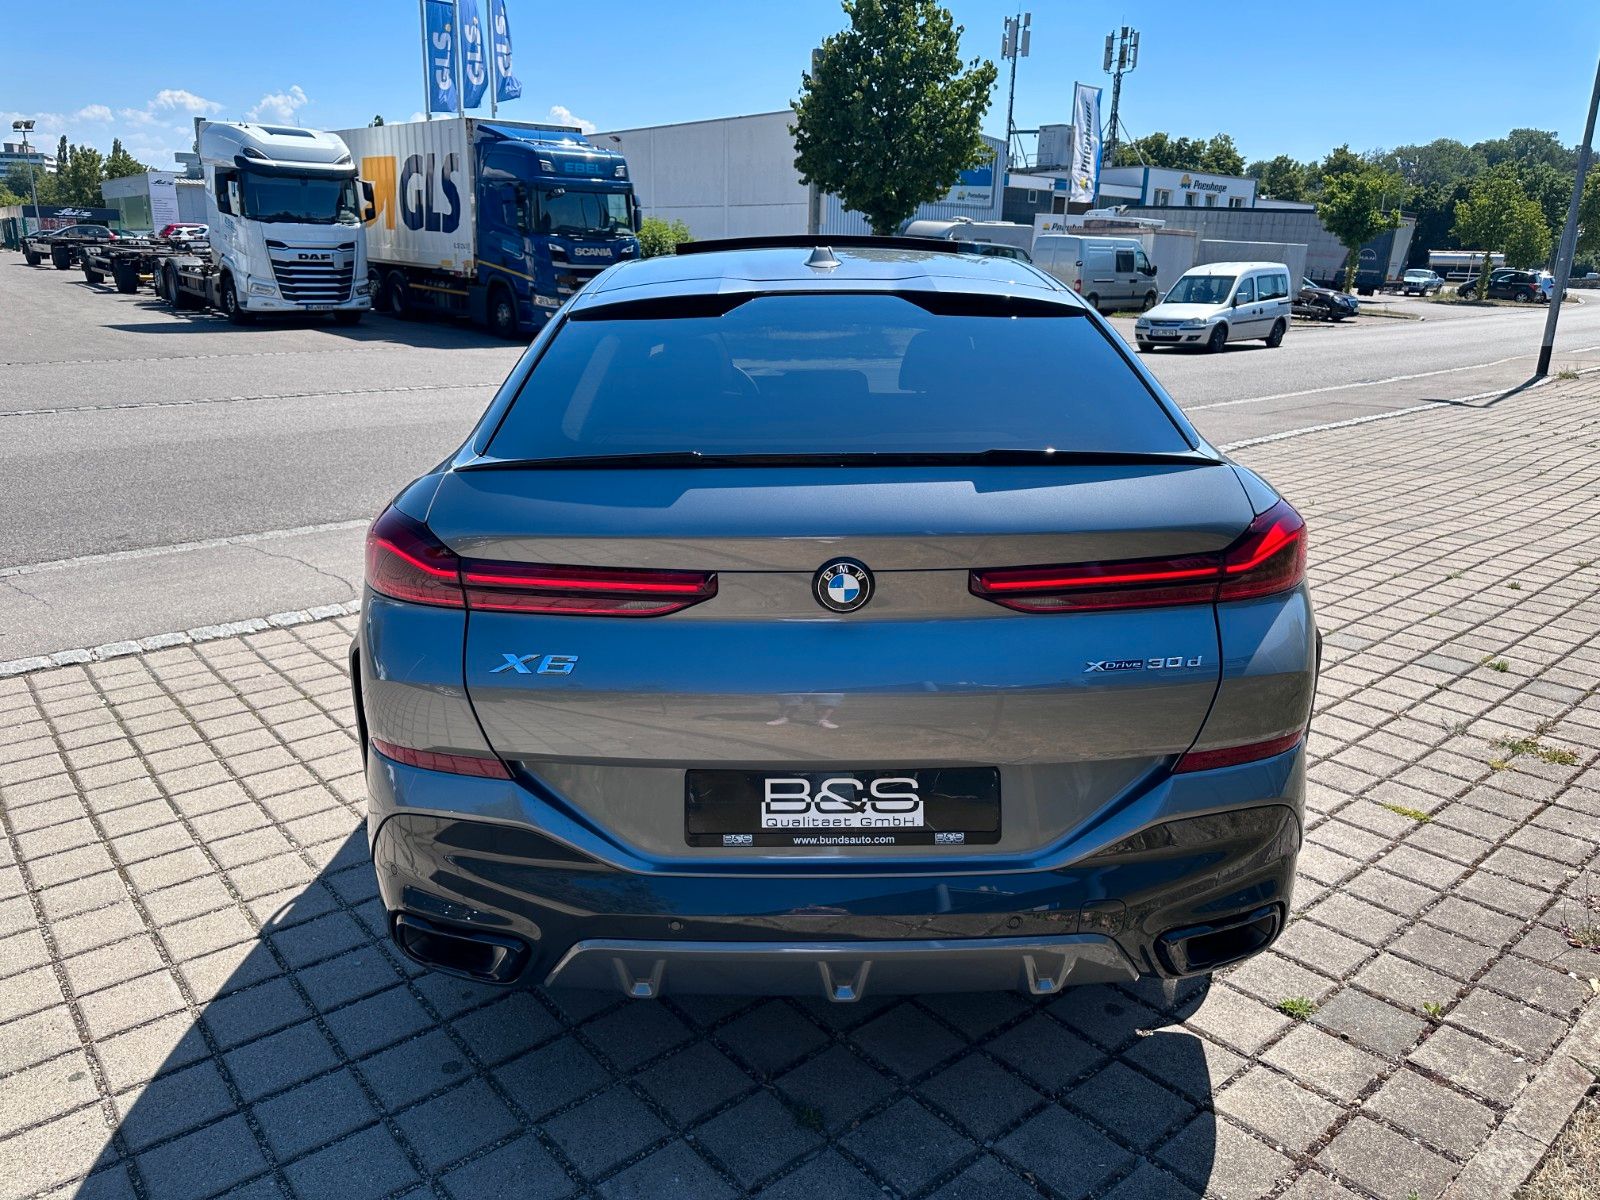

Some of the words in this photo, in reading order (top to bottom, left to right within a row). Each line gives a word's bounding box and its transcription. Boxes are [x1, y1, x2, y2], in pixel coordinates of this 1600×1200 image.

[564, 162, 603, 173] EBEL
[399, 152, 460, 233] GLS
[574, 247, 612, 257] SCANIA
[823, 565, 865, 581] BMW
[489, 653, 579, 675] X6
[763, 778, 919, 814] B&S
[765, 817, 852, 828] Qualitaet
[793, 835, 895, 845] www.bundsauto.com
